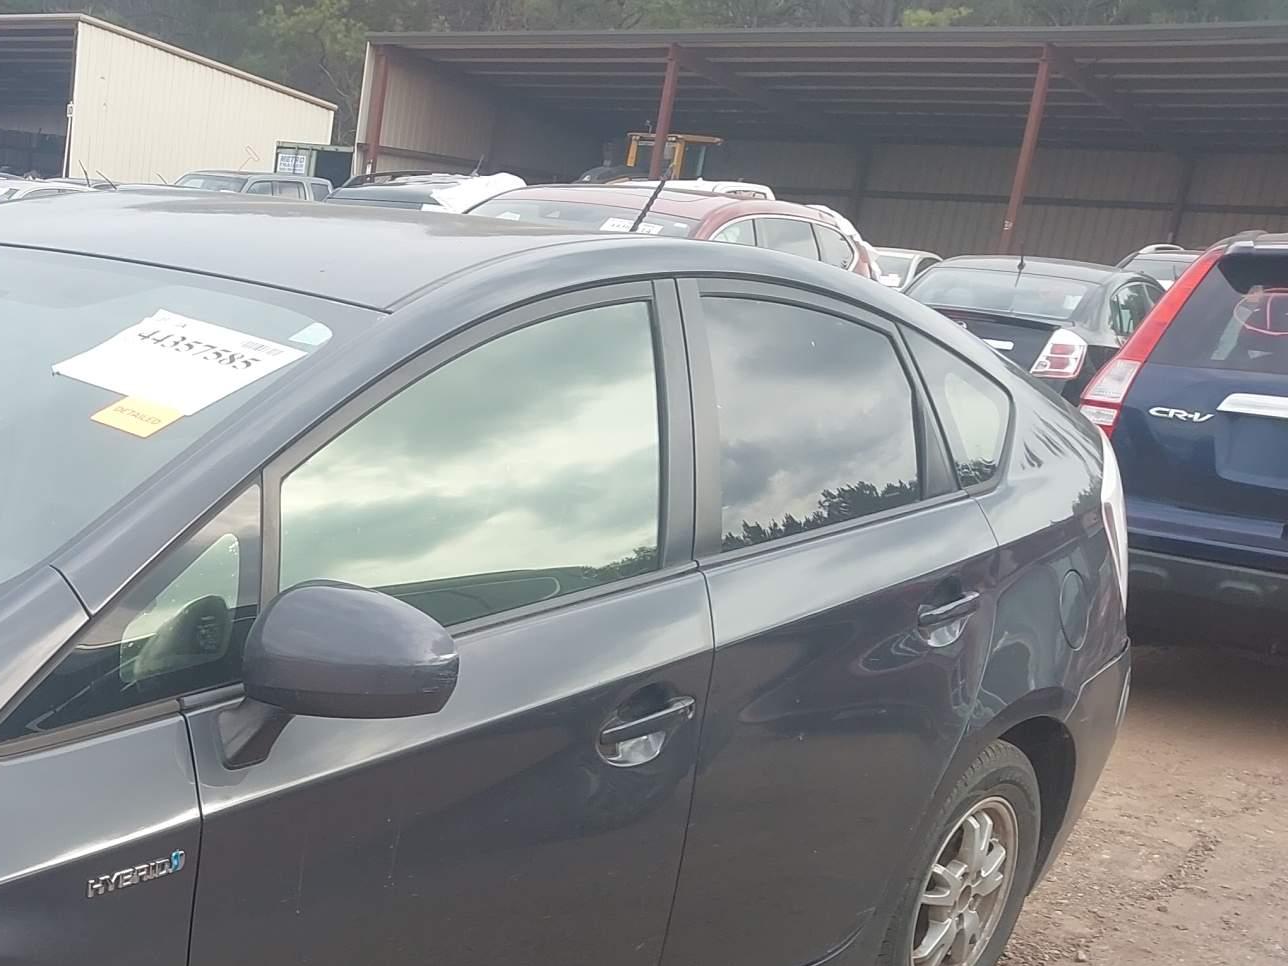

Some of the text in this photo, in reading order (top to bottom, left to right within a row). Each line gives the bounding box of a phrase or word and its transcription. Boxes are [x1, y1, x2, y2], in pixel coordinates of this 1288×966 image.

[138, 329, 262, 370] 44357585
[112, 404, 162, 425] DETAILED
[87, 858, 172, 898] HYBRID
